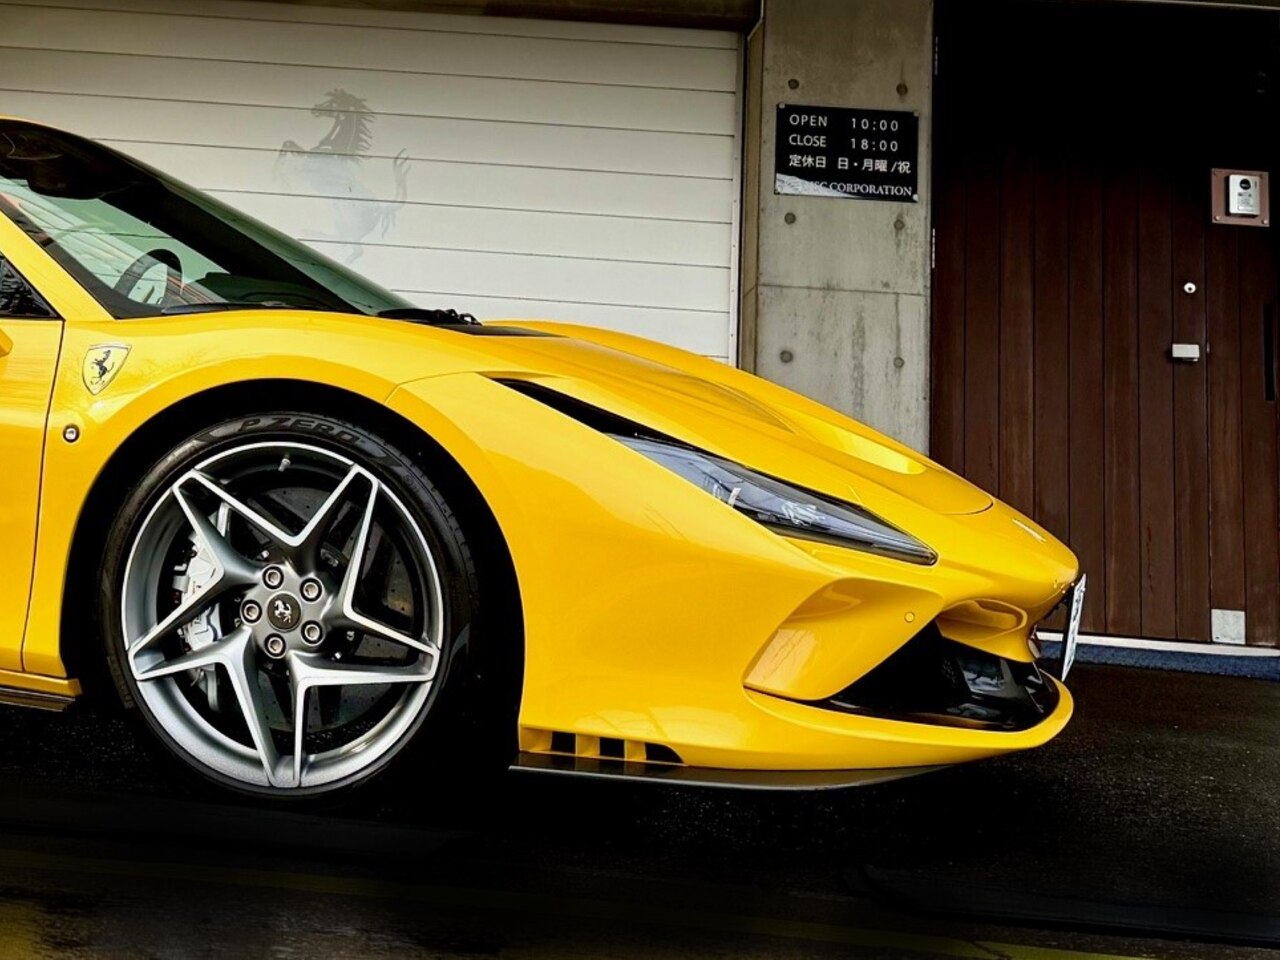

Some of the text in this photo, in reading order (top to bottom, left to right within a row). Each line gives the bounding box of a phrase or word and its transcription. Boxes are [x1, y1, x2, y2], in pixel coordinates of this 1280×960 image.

[789, 114, 898, 131] OPEN 10:00
[789, 134, 898, 151] CLOSE 18:00
[789, 154, 826, 169] 定休日
[829, 182, 912, 196] CORPORATION
